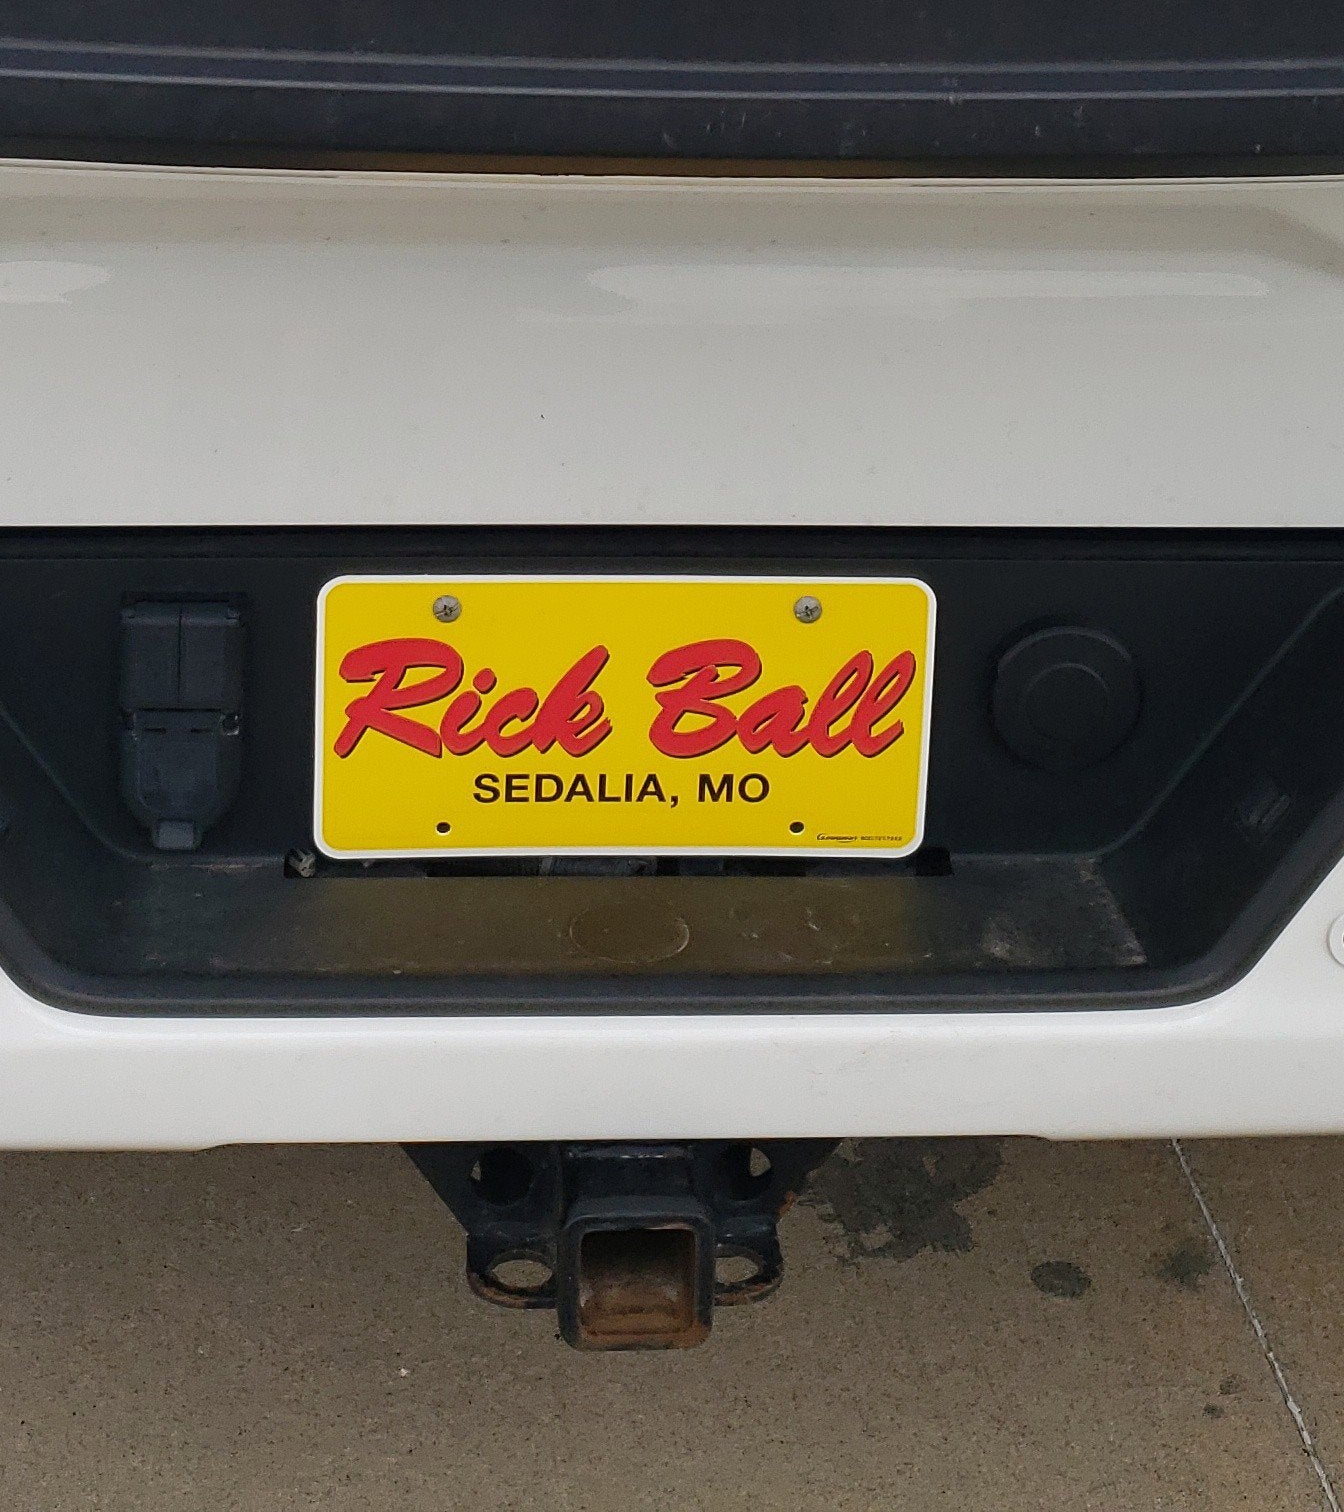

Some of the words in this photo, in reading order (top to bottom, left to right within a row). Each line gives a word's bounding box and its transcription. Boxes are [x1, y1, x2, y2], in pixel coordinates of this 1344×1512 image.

[334, 637, 613, 759] Rick
[647, 638, 917, 759] Ball
[472, 772, 680, 809] SEDALIA,
[697, 772, 771, 803] MO
